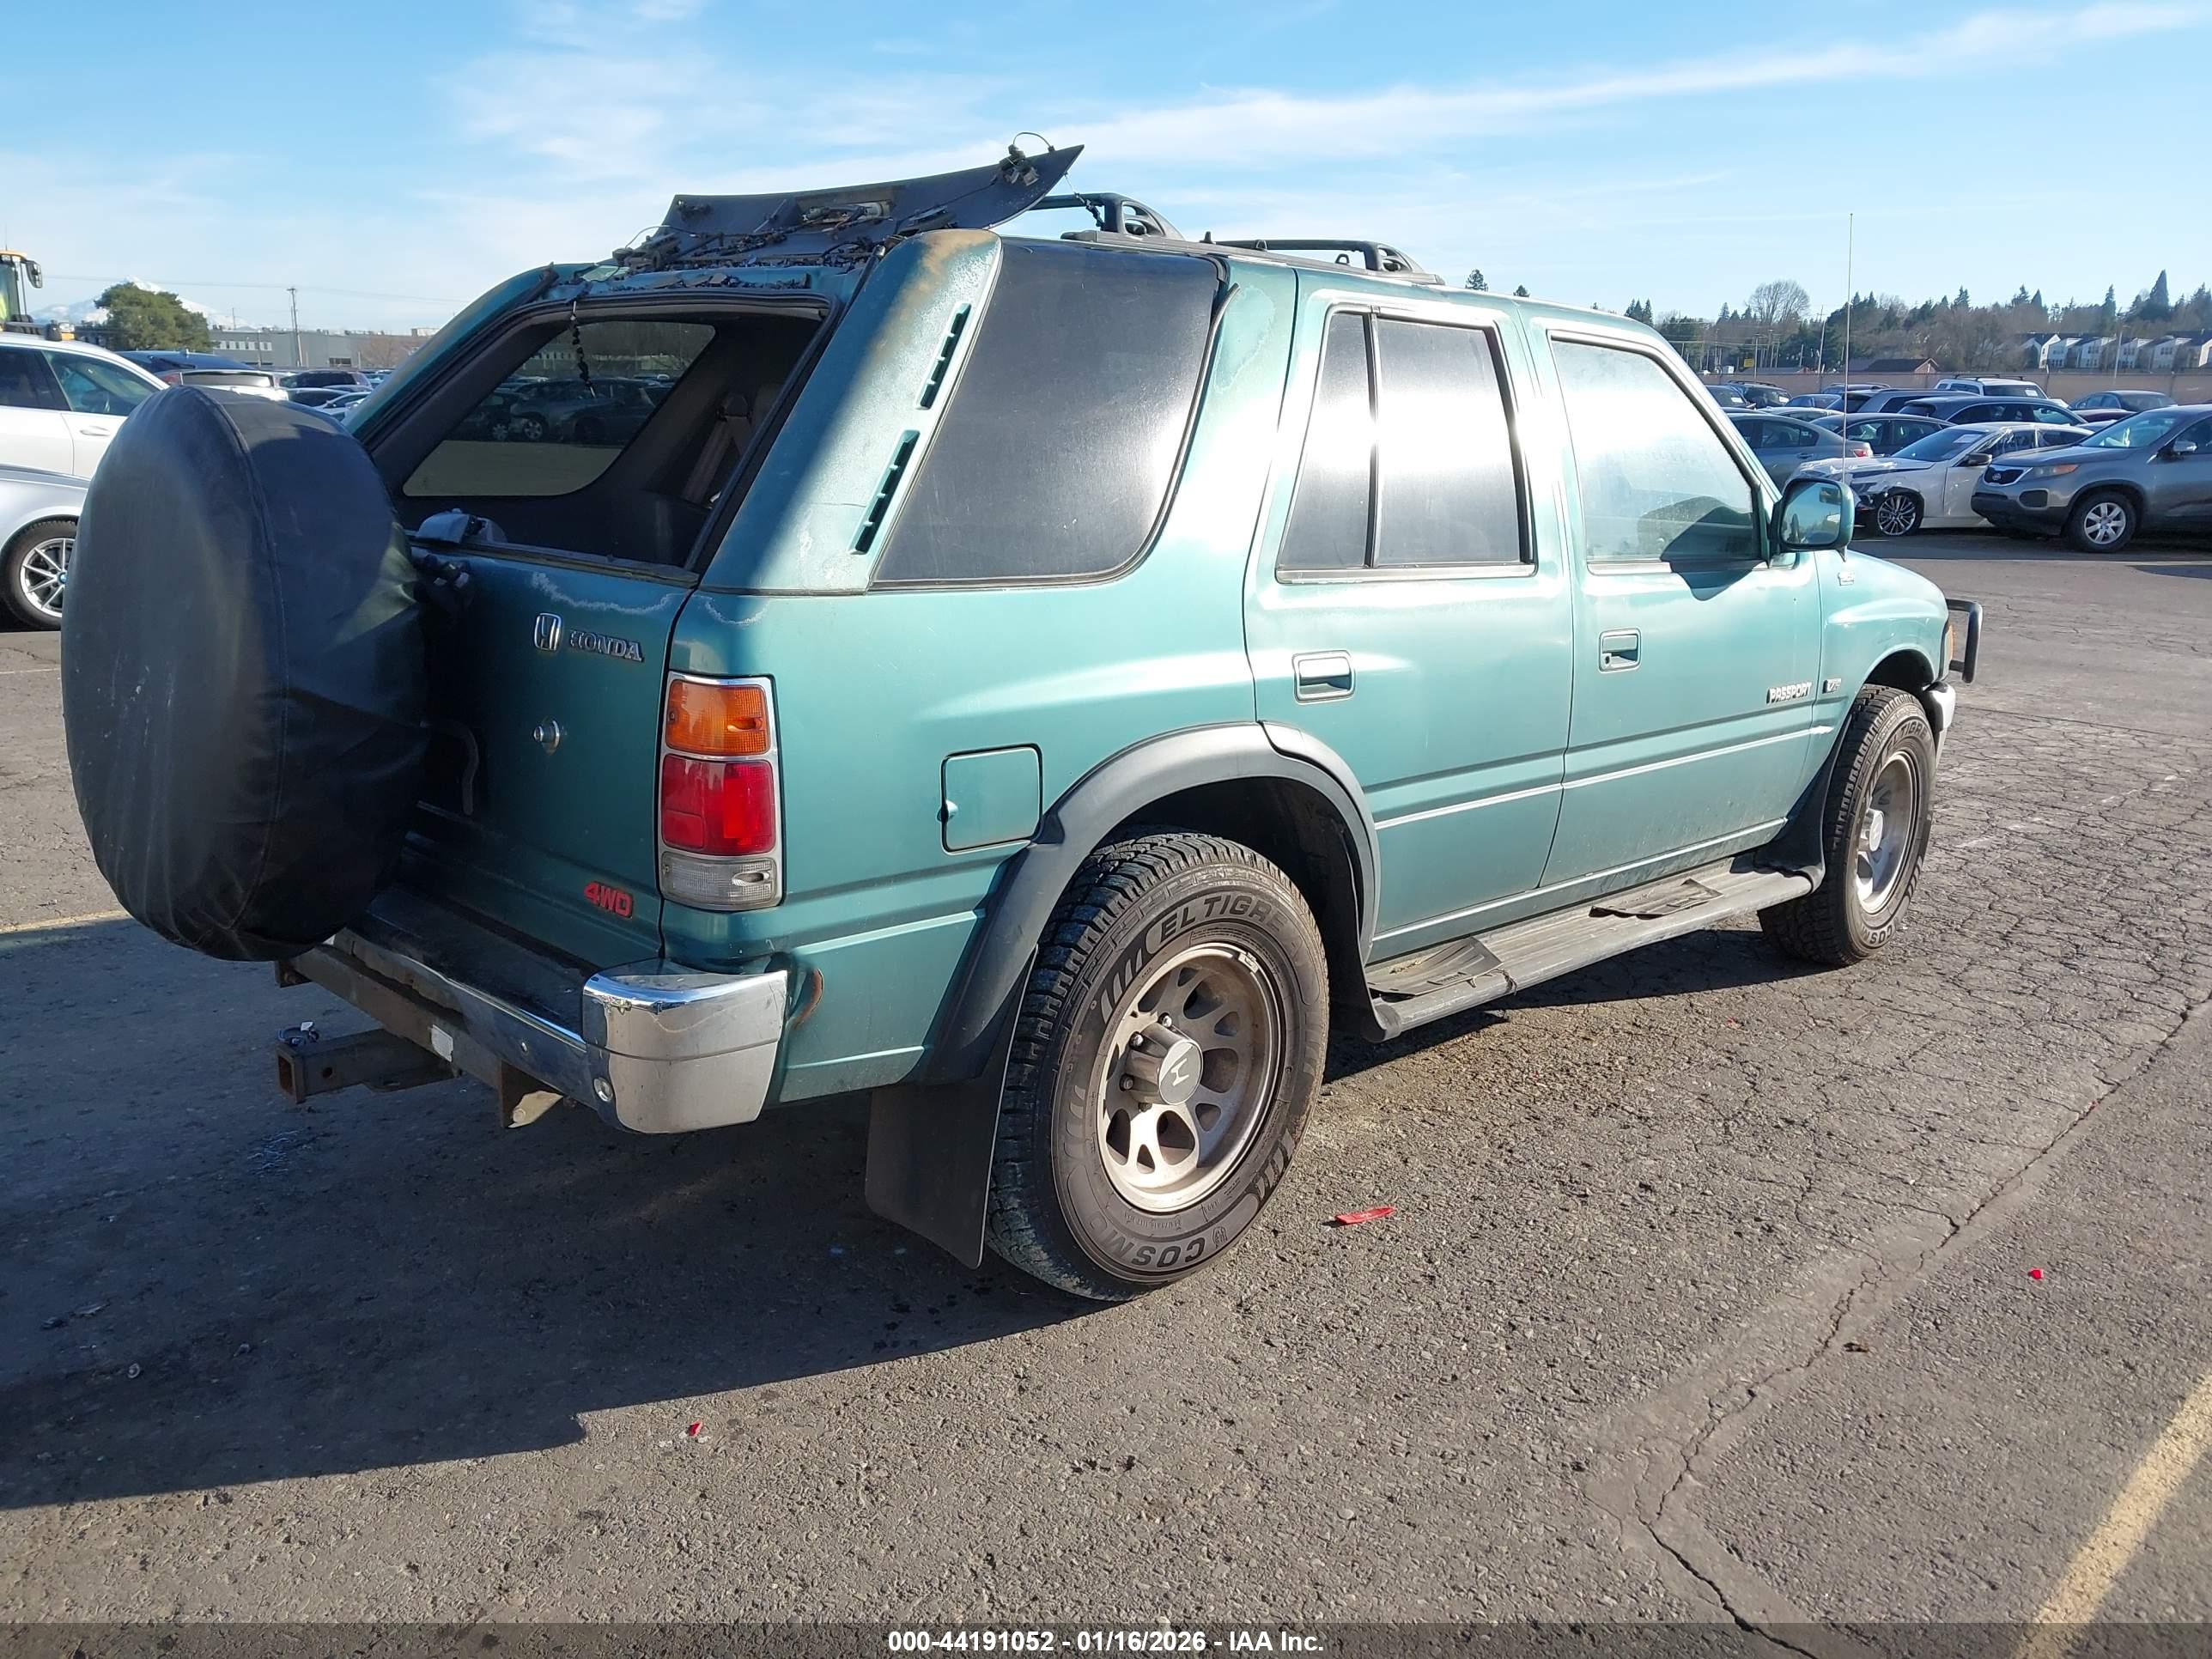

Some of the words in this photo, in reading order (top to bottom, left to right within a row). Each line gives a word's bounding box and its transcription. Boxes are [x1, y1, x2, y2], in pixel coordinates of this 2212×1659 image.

[569, 629, 644, 663] HONDA
[1767, 681, 1813, 704] PASSPORT
[583, 881, 634, 919] 4WD
[1160, 907, 1196, 943] EL
[1204, 895, 1288, 932] TIGRE
